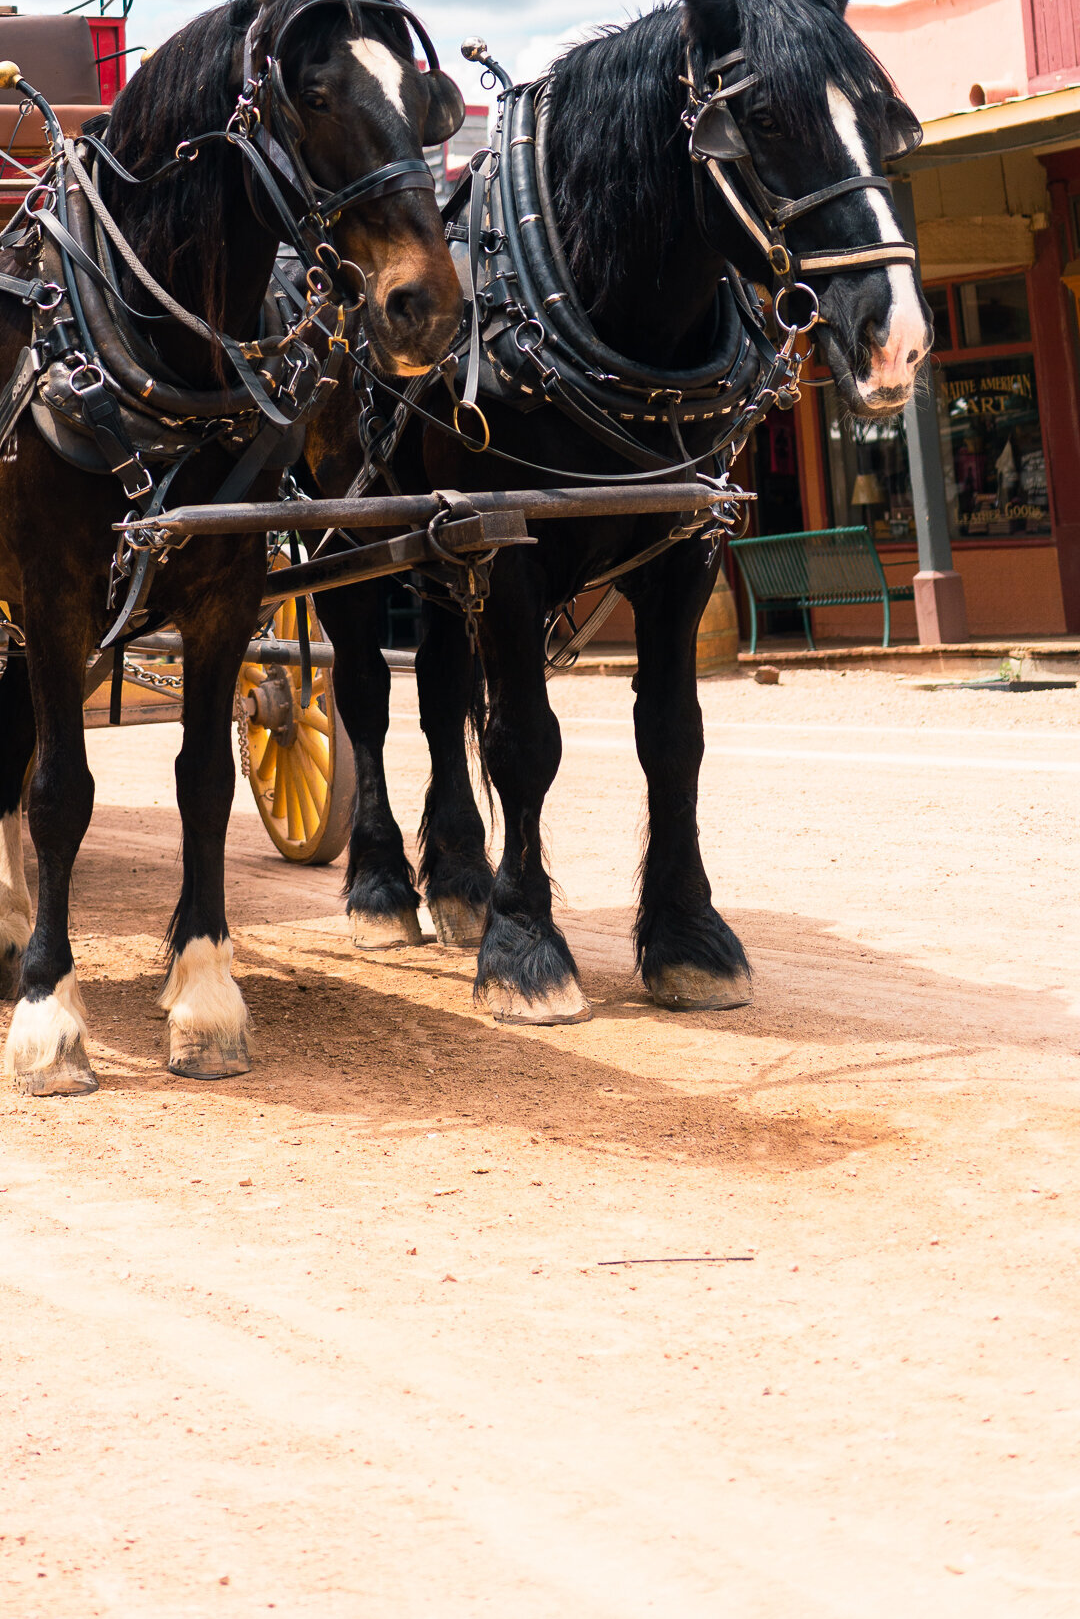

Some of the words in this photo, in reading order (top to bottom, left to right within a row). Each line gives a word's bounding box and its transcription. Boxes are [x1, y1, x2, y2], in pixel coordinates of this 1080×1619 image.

[940, 379, 976, 400] NATIVE
[980, 373, 1032, 400] AMERICAN
[967, 395, 1008, 415] ART
